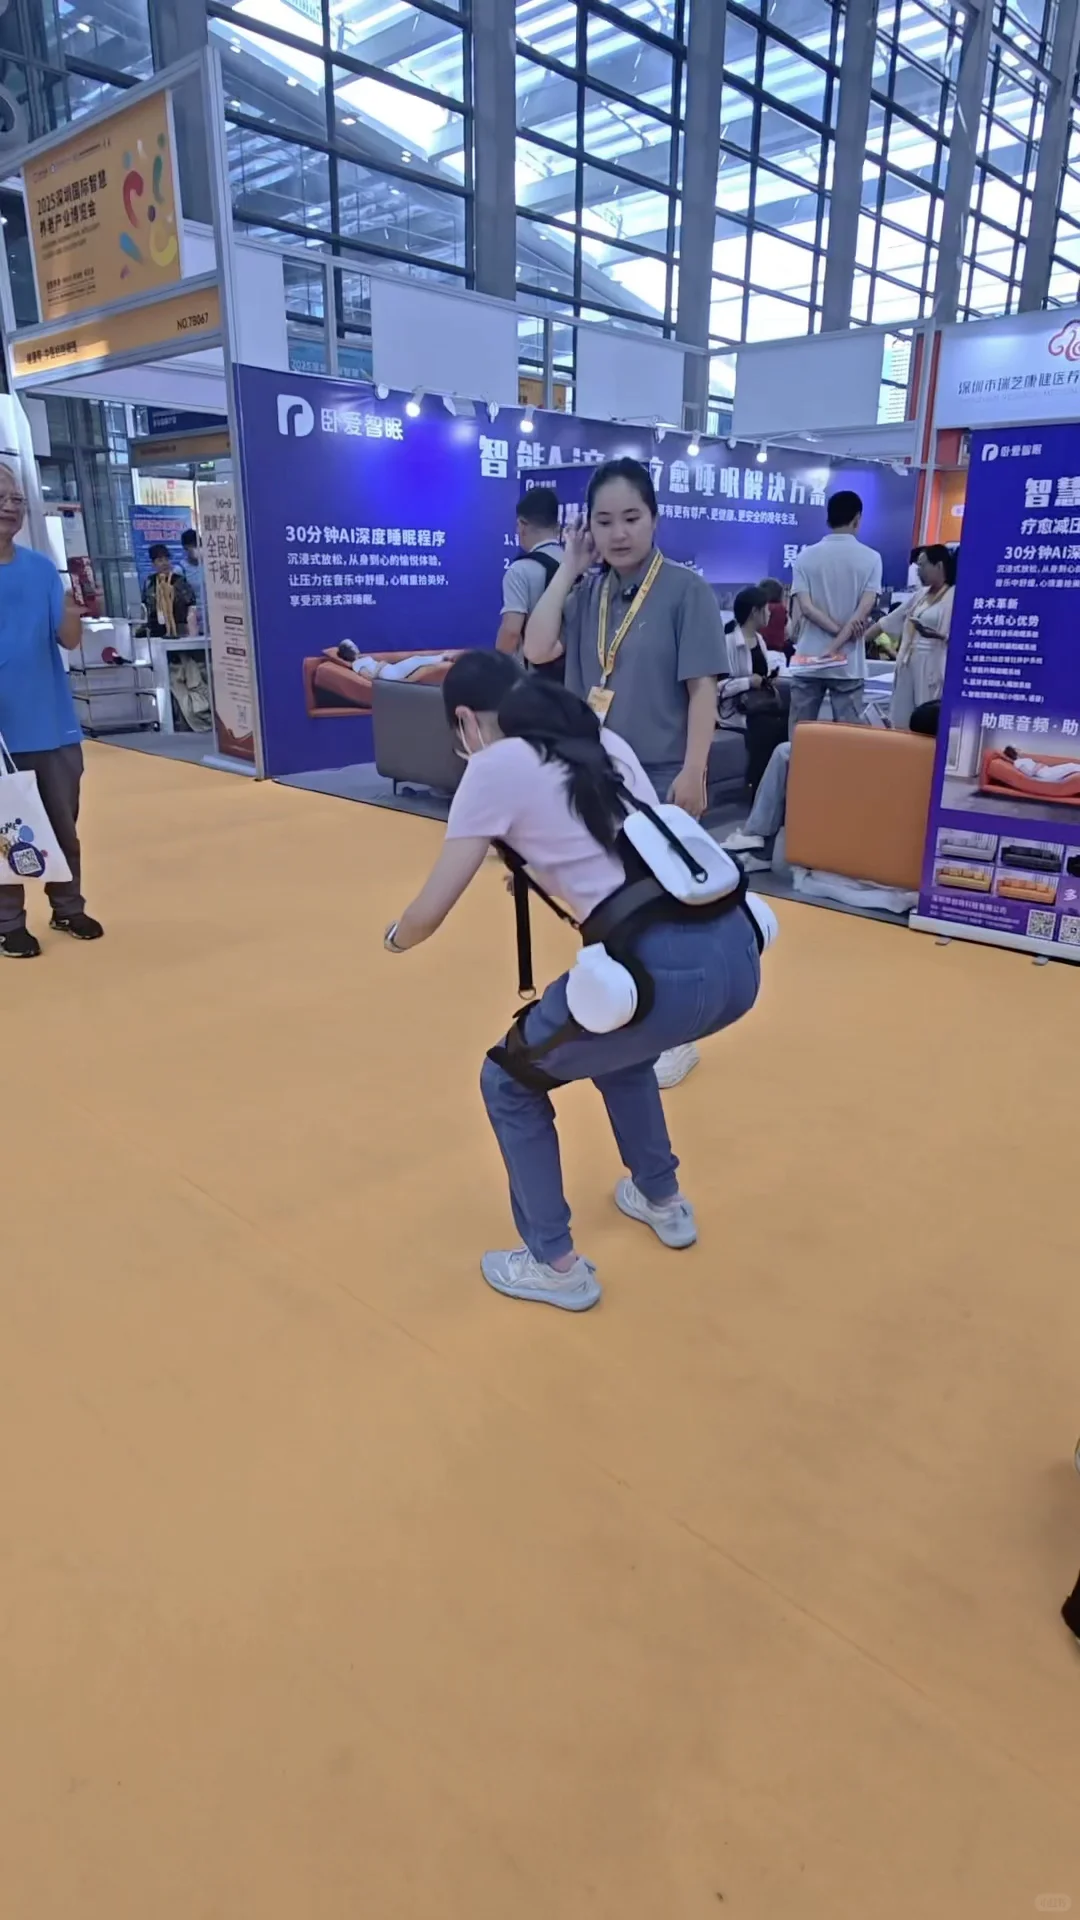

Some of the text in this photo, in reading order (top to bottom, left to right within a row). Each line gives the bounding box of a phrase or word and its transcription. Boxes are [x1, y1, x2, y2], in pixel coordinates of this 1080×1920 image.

[321, 407, 404, 441] 卧爱智眠
[1024, 476, 1080, 508] 智慧
[285, 525, 447, 547] 30分钟AI深度睡眠程序
[1020, 517, 1080, 535] 疗愈减压
[973, 598, 1018, 610] 技术革新
[971, 614, 1040, 627] 六大核心优势
